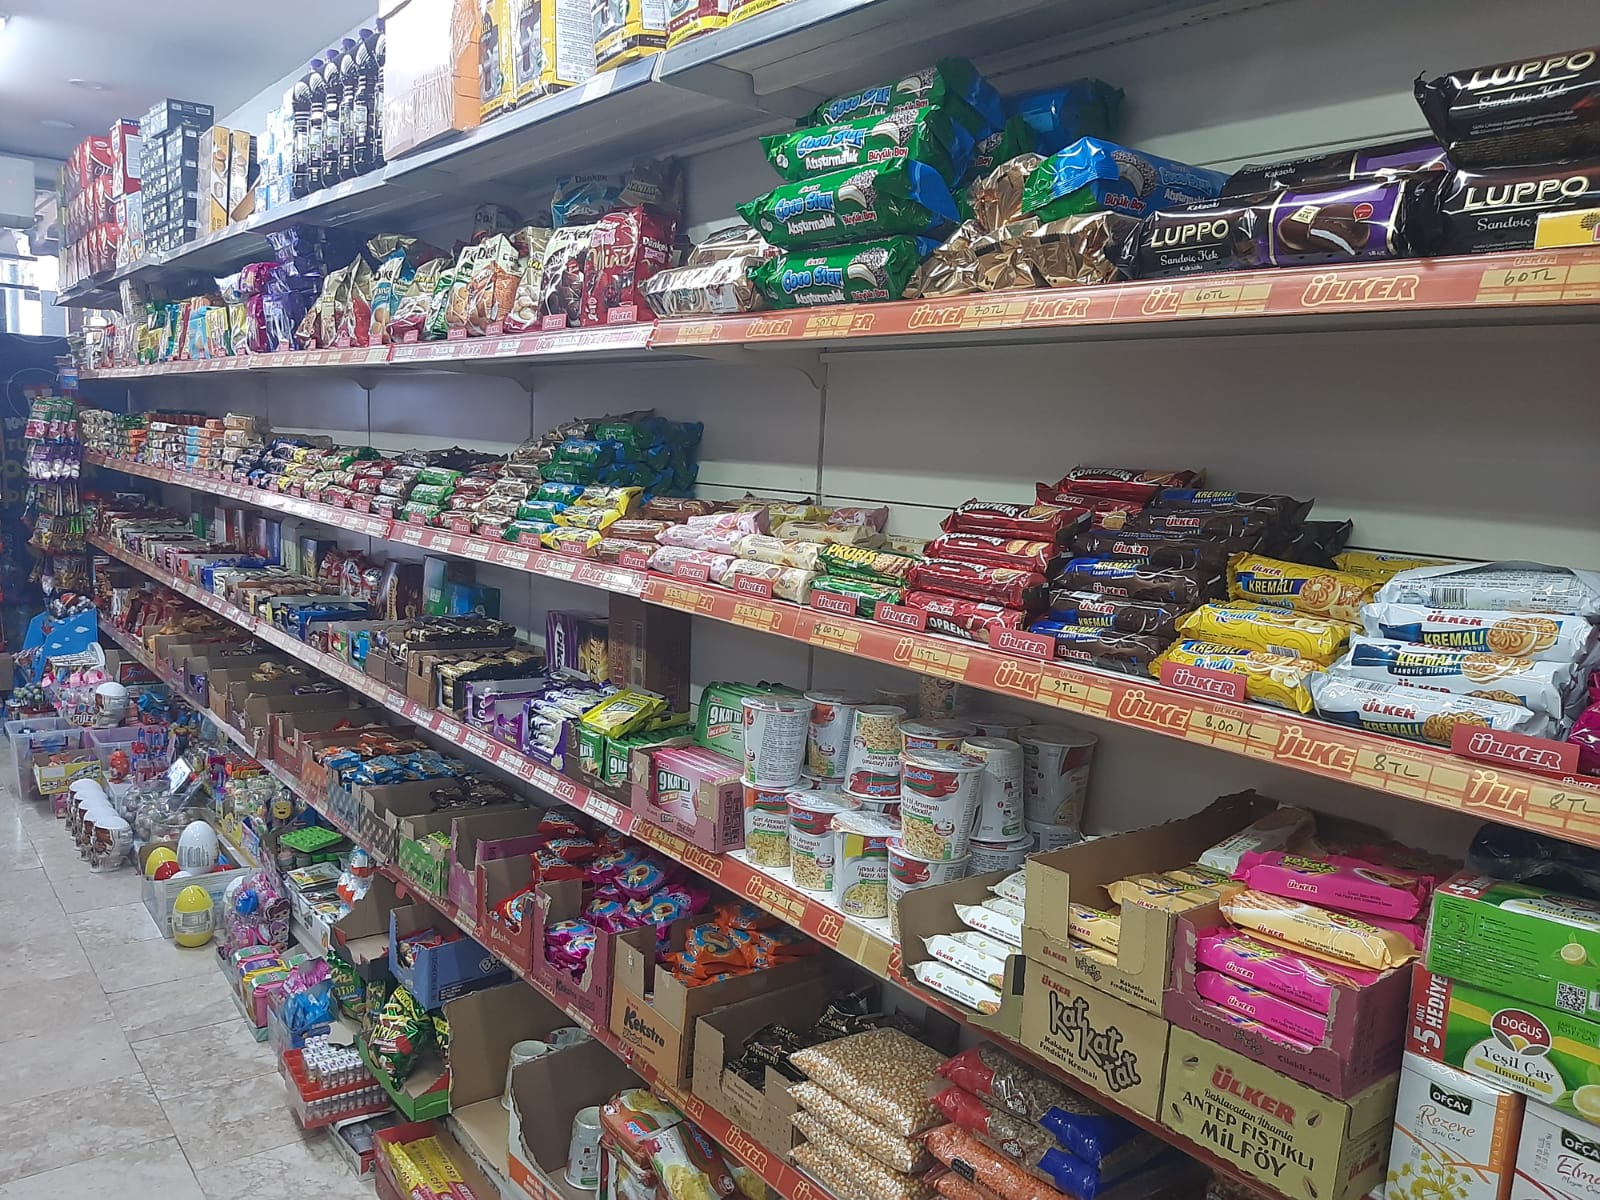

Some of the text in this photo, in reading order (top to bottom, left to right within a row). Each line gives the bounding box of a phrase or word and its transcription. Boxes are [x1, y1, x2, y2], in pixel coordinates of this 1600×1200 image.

[1466, 51, 1596, 90] LUPPO
[797, 129, 866, 157] Coco Star
[893, 146, 909, 159] Boy
[805, 149, 859, 170] Atıştırmalık
[1463, 175, 1590, 211] LUPPO
[774, 191, 835, 221] Coco Star
[787, 214, 836, 235] Atıştırmalık
[1151, 218, 1230, 249] LUPPO
[1477, 215, 1533, 231] Sandviç
[1160, 249, 1220, 266] Sandviç Kek
[781, 266, 844, 293] Coco Star
[1301, 273, 1420, 307] ÜLKER
[746, 318, 793, 338] ÜLKER
[1069, 467, 1132, 482] ÇOKOPRENS
[1166, 514, 1200, 527] ÜLKER
[1112, 541, 1149, 555] ÜLKER
[623, 554, 646, 568] ÜLKER
[678, 564, 705, 579] ÜLKER
[1251, 563, 1282, 577] ÜLKER
[738, 578, 767, 595] ÜLKER
[1093, 583, 1128, 597] ÜLKER
[1248, 578, 1294, 594] KREMALI
[817, 594, 851, 613] ÜLKER
[1078, 600, 1115, 614] ÜLKER
[880, 605, 919, 626] ÜLKER
[1426, 610, 1483, 627] ÜLKER
[999, 633, 1048, 656] ÜLKER
[1189, 641, 1242, 654] KREMALI
[1423, 629, 1485, 648] KREMALI
[1057, 646, 1091, 660] ÜLKER
[1396, 652, 1463, 667] KREMALI
[994, 661, 1041, 699] ÜLK
[1172, 668, 1236, 696] ÜLKER
[1117, 689, 1190, 731] ÜLKE
[1213, 704, 1244, 717] ÜLKER
[1361, 699, 1417, 720] ÜLKER
[1361, 720, 1421, 737] KREMALI
[1276, 725, 1358, 772] ÜLKE
[1469, 731, 1562, 770] ÜLKER
[683, 842, 724, 878] ÜLKER
[1287, 879, 1318, 894] ÜLKER
[968, 918, 988, 930] ÜLKER
[1069, 921, 1091, 937] ÜLKER
[1257, 923, 1286, 940] ÜLKER
[935, 949, 954, 963] ÜLKER
[1042, 945, 1068, 963] ÜLKER
[1226, 961, 1254, 980] ÜLKER
[924, 975, 943, 989] ÜLKER
[1041, 974, 1071, 997] ÜLKER
[1228, 995, 1256, 1014] ÜLKER
[1425, 973, 1449, 1030] HEDİYE
[1415, 1003, 1426, 1023] ADET
[623, 1005, 665, 1048] Kekstra
[1500, 1014, 1543, 1040] DOĞUŞ
[1044, 1035, 1075, 1058] Kakaolu
[1039, 1040, 1099, 1081] Fındıklı Kremalı
[1482, 1045, 1554, 1083] Yeşil Çay
[1103, 1050, 1142, 1093] tat
[1494, 1065, 1536, 1088] limonlu
[1203, 1087, 1256, 1122] Baklavadan
[1211, 1064, 1296, 1128] ÜLKER
[1432, 1091, 1469, 1112] OFÇAY
[1182, 1091, 1315, 1172] ANTEP FISTIKLI
[1419, 1105, 1476, 1138] Rezene
[724, 1124, 769, 1174] ÜLKER
[1564, 1137, 1600, 1159] OFÇA
